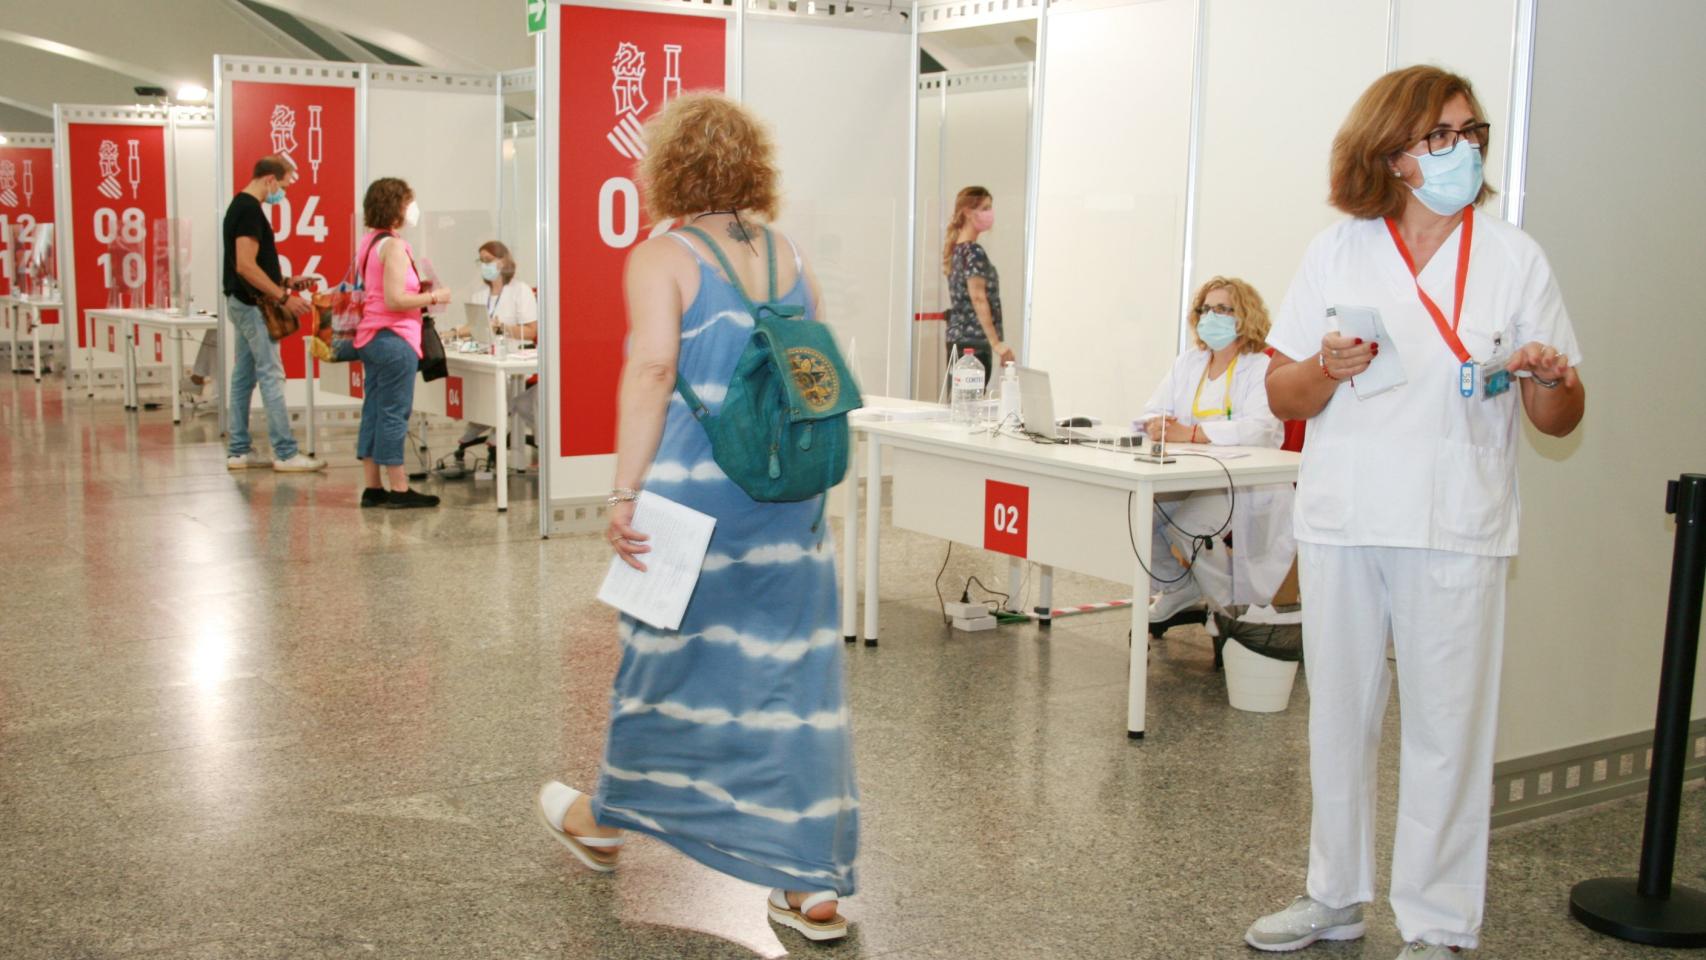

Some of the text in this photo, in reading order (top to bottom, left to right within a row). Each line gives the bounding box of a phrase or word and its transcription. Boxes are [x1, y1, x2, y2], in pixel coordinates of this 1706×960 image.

[0, 213, 36, 242] 12
[93, 207, 146, 244] 08
[262, 196, 328, 242] 04
[97, 253, 146, 288] 10
[278, 254, 328, 303] 6
[449, 389, 459, 406] 04
[993, 503, 1019, 535] 02
